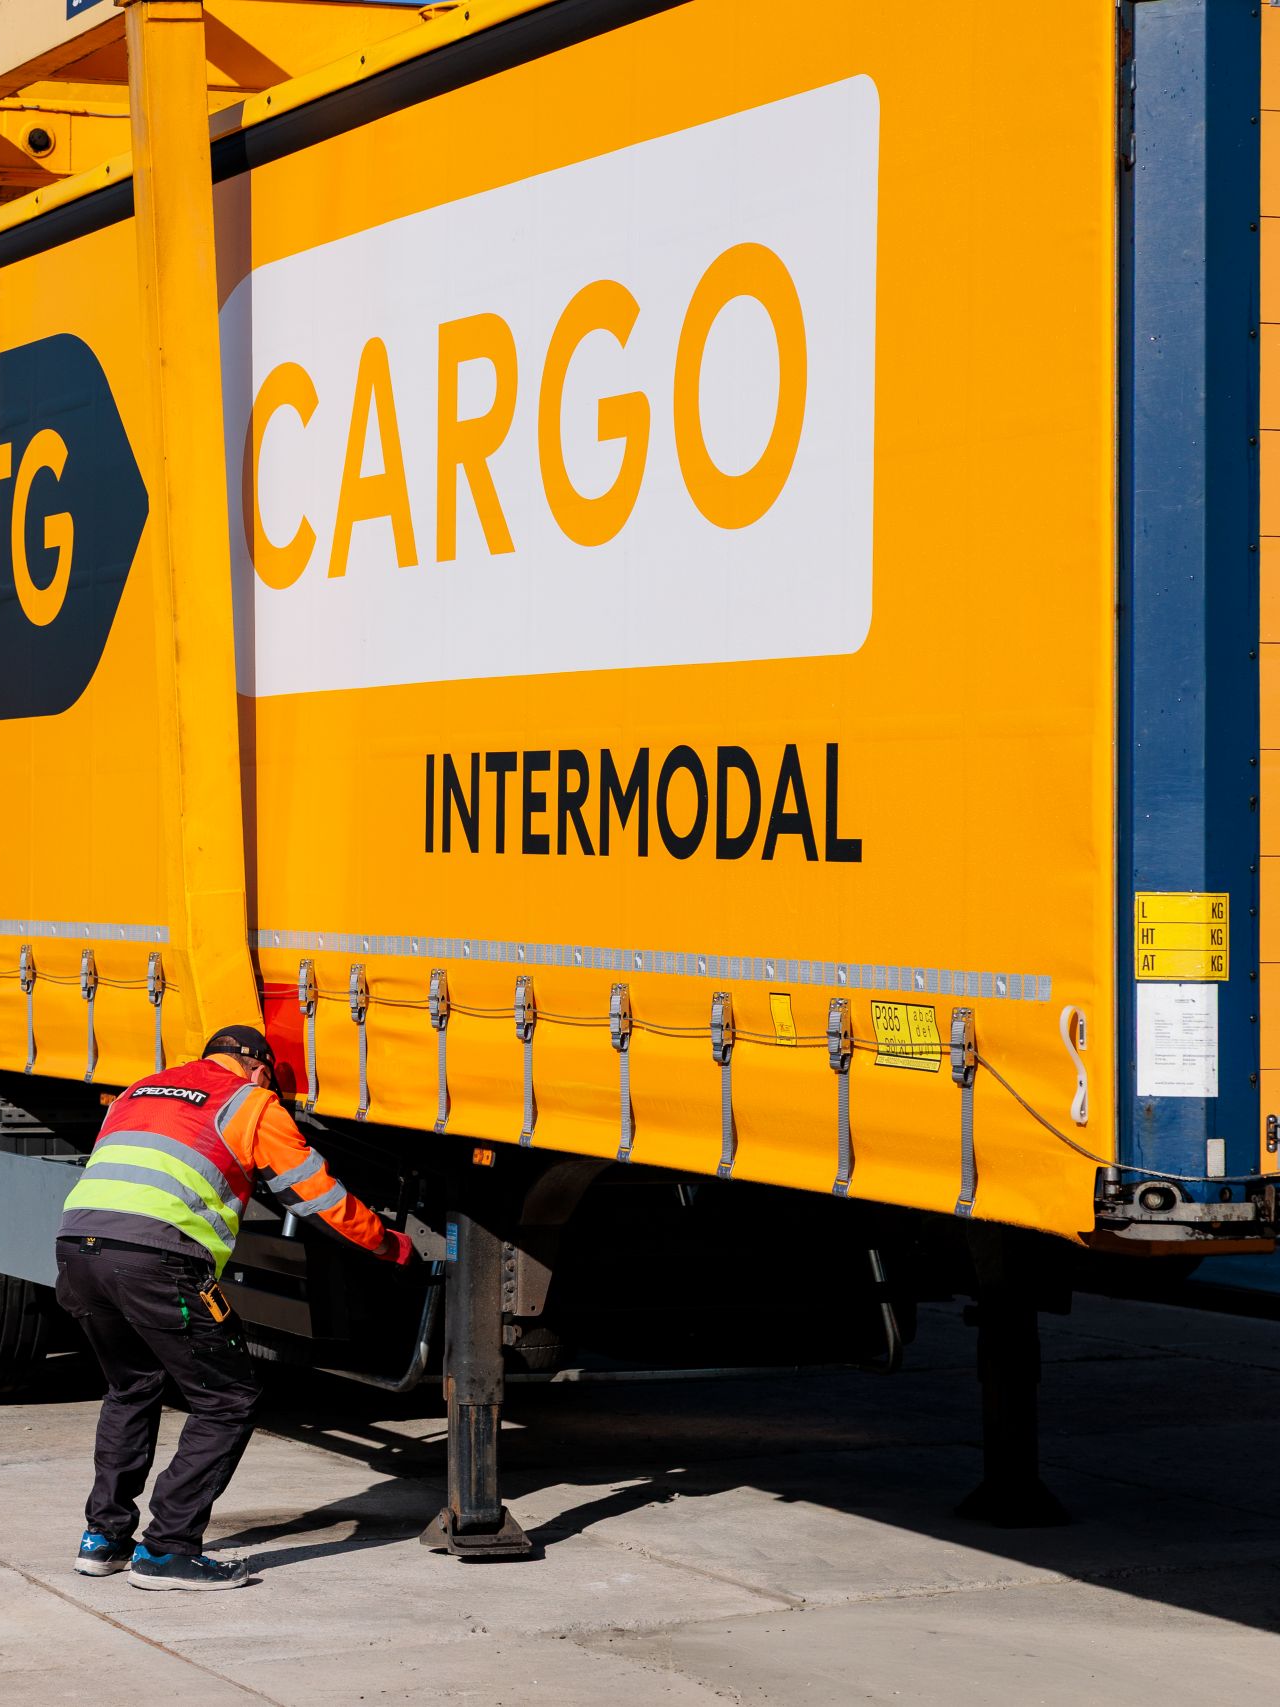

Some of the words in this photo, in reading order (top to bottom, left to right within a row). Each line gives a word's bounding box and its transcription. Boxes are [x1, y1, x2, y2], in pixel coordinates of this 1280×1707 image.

[242, 242, 807, 590] CARGO
[425, 743, 862, 862] INTERMODAL
[1142, 902, 1148, 918] L
[1211, 902, 1224, 919] KG
[1142, 928, 1156, 945] HT
[1210, 928, 1223, 945] KG
[1142, 955, 1157, 971] AT
[1210, 955, 1223, 972] KG
[875, 1005, 901, 1031] P385
[132, 1087, 207, 1103] SPEDCONT
